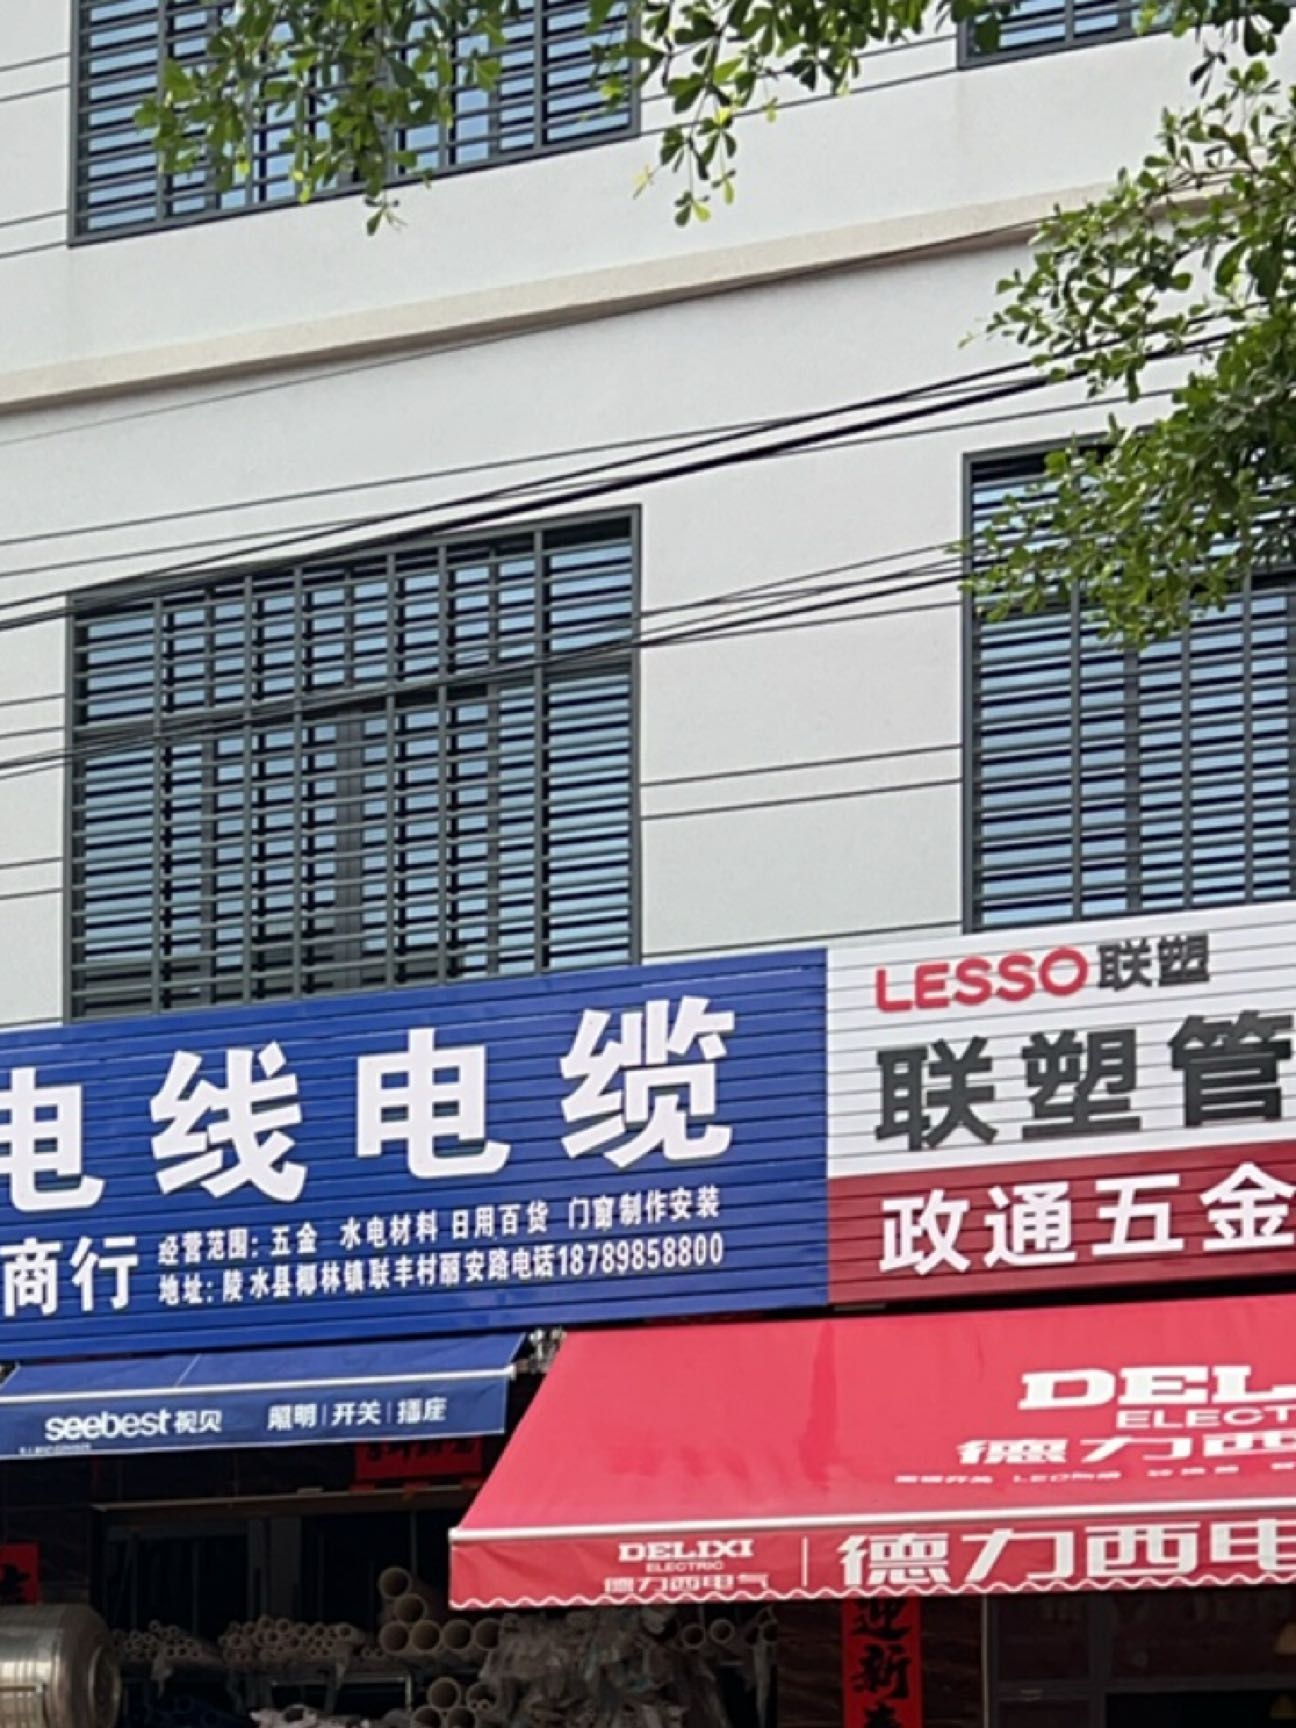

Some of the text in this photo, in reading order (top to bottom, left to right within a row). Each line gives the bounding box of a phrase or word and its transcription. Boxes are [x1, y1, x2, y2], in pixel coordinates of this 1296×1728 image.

[875, 934, 1210, 1013] LESSO 联塑
[875, 1009, 1295, 1152] 联塑管
[340, 1209, 438, 1250] 水电材料
[452, 1200, 549, 1240] 日用百货
[568, 1184, 721, 1230] 门窗制作安装
[879, 1162, 1296, 1277] 政通五金
[44, 1407, 171, 1442] seebest
[331, 1399, 382, 1427] 开关
[618, 1539, 754, 1563] DELIXI
[645, 1560, 724, 1573] ELECTRIC
[836, 1518, 1296, 1587] 德力西电
